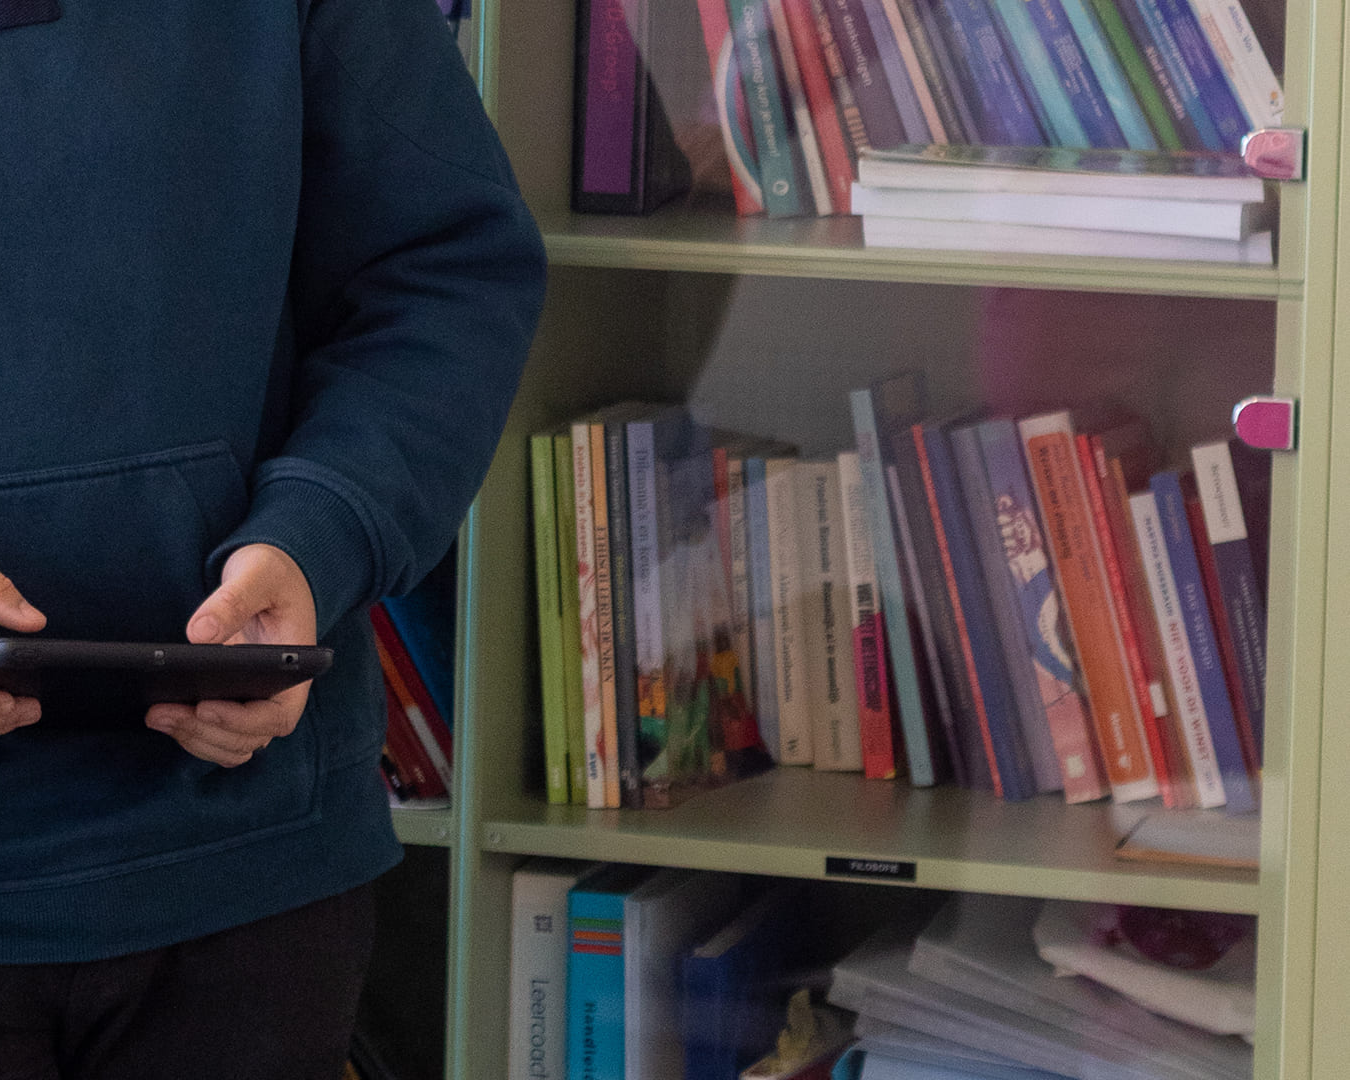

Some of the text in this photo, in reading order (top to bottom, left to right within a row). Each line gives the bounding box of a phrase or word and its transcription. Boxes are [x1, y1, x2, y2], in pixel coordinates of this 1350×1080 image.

[744, 6, 760, 39] Goed
[747, 41, 765, 84] gedrag
[842, 14, 874, 87] deskundigen
[756, 84, 771, 108] kun
[759, 109, 772, 123] je
[635, 449, 653, 522] Dilemma's
[637, 524, 651, 542] en
[850, 862, 899, 874] FILOSOFIE
